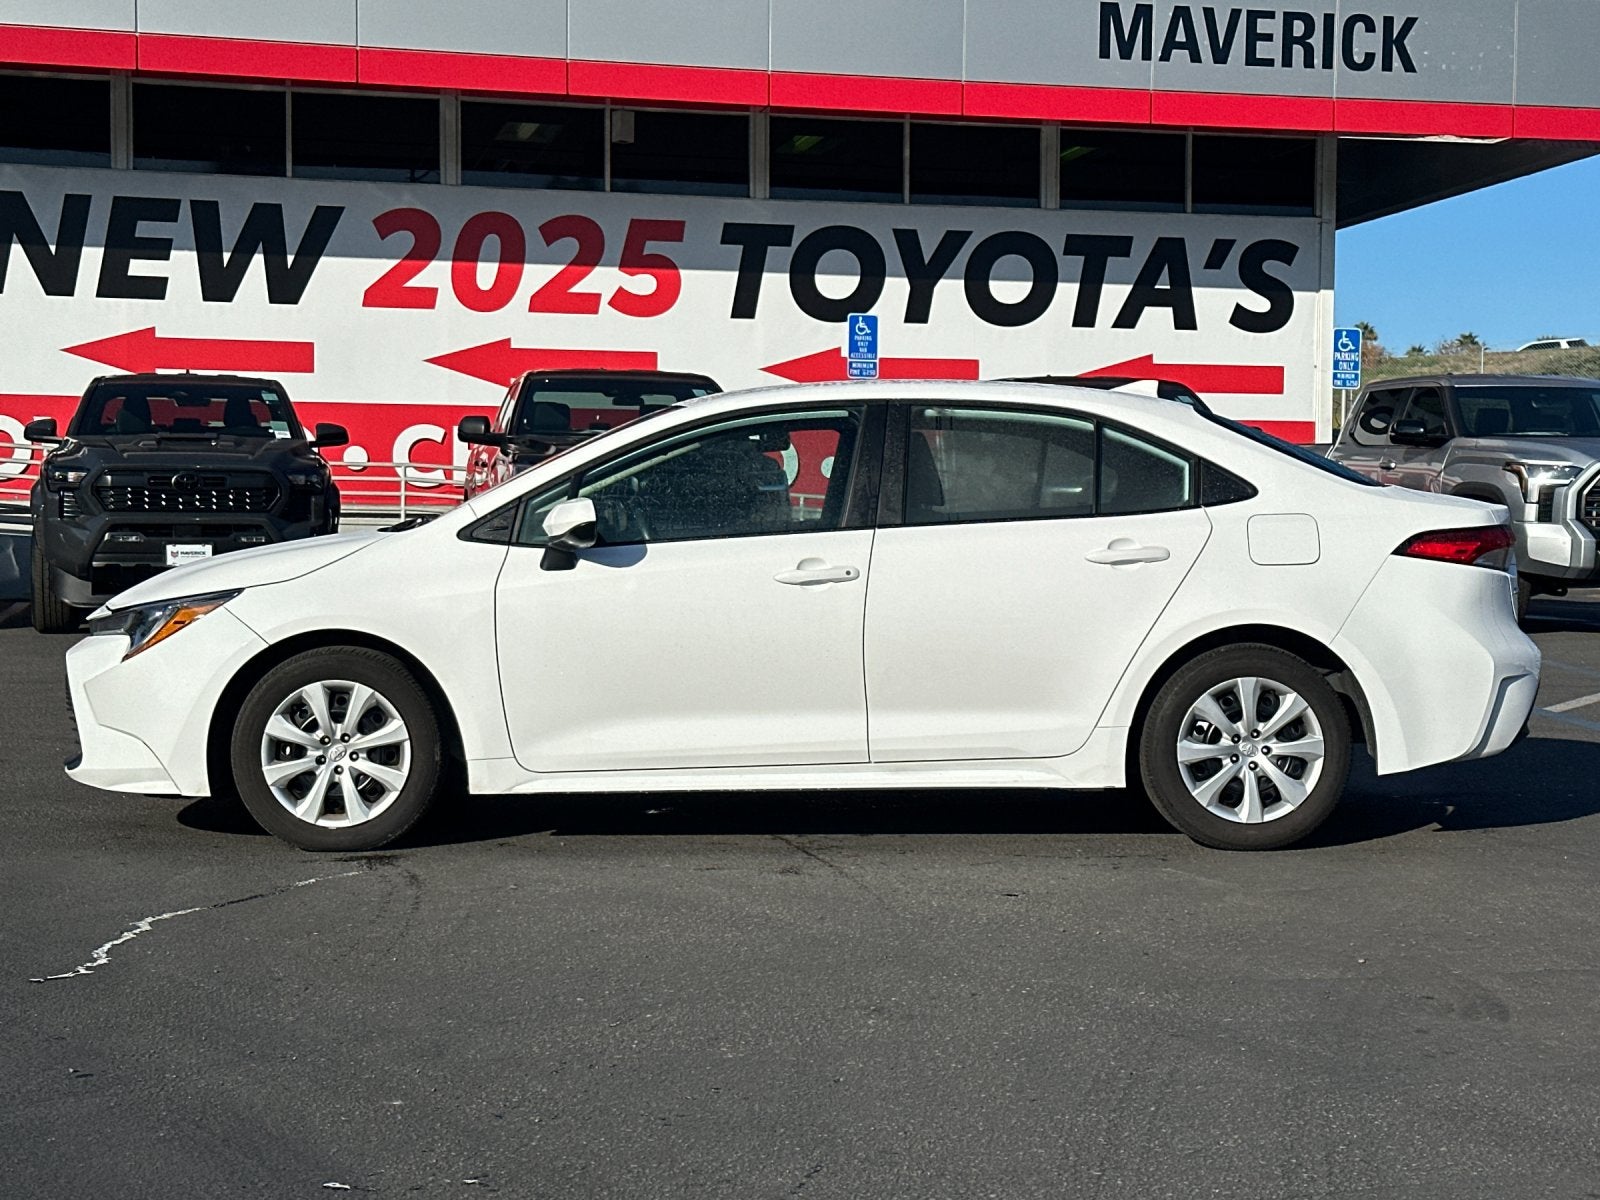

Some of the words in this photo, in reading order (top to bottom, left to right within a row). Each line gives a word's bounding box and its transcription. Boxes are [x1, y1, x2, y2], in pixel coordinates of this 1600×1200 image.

[1099, 1, 1418, 73] MAVERICK
[0, 190, 346, 305] NEW
[362, 207, 687, 318] 2025
[720, 222, 1300, 333] TOYOTA'S
[1334, 351, 1359, 361] PARKING
[1338, 361, 1355, 370] ONLY
